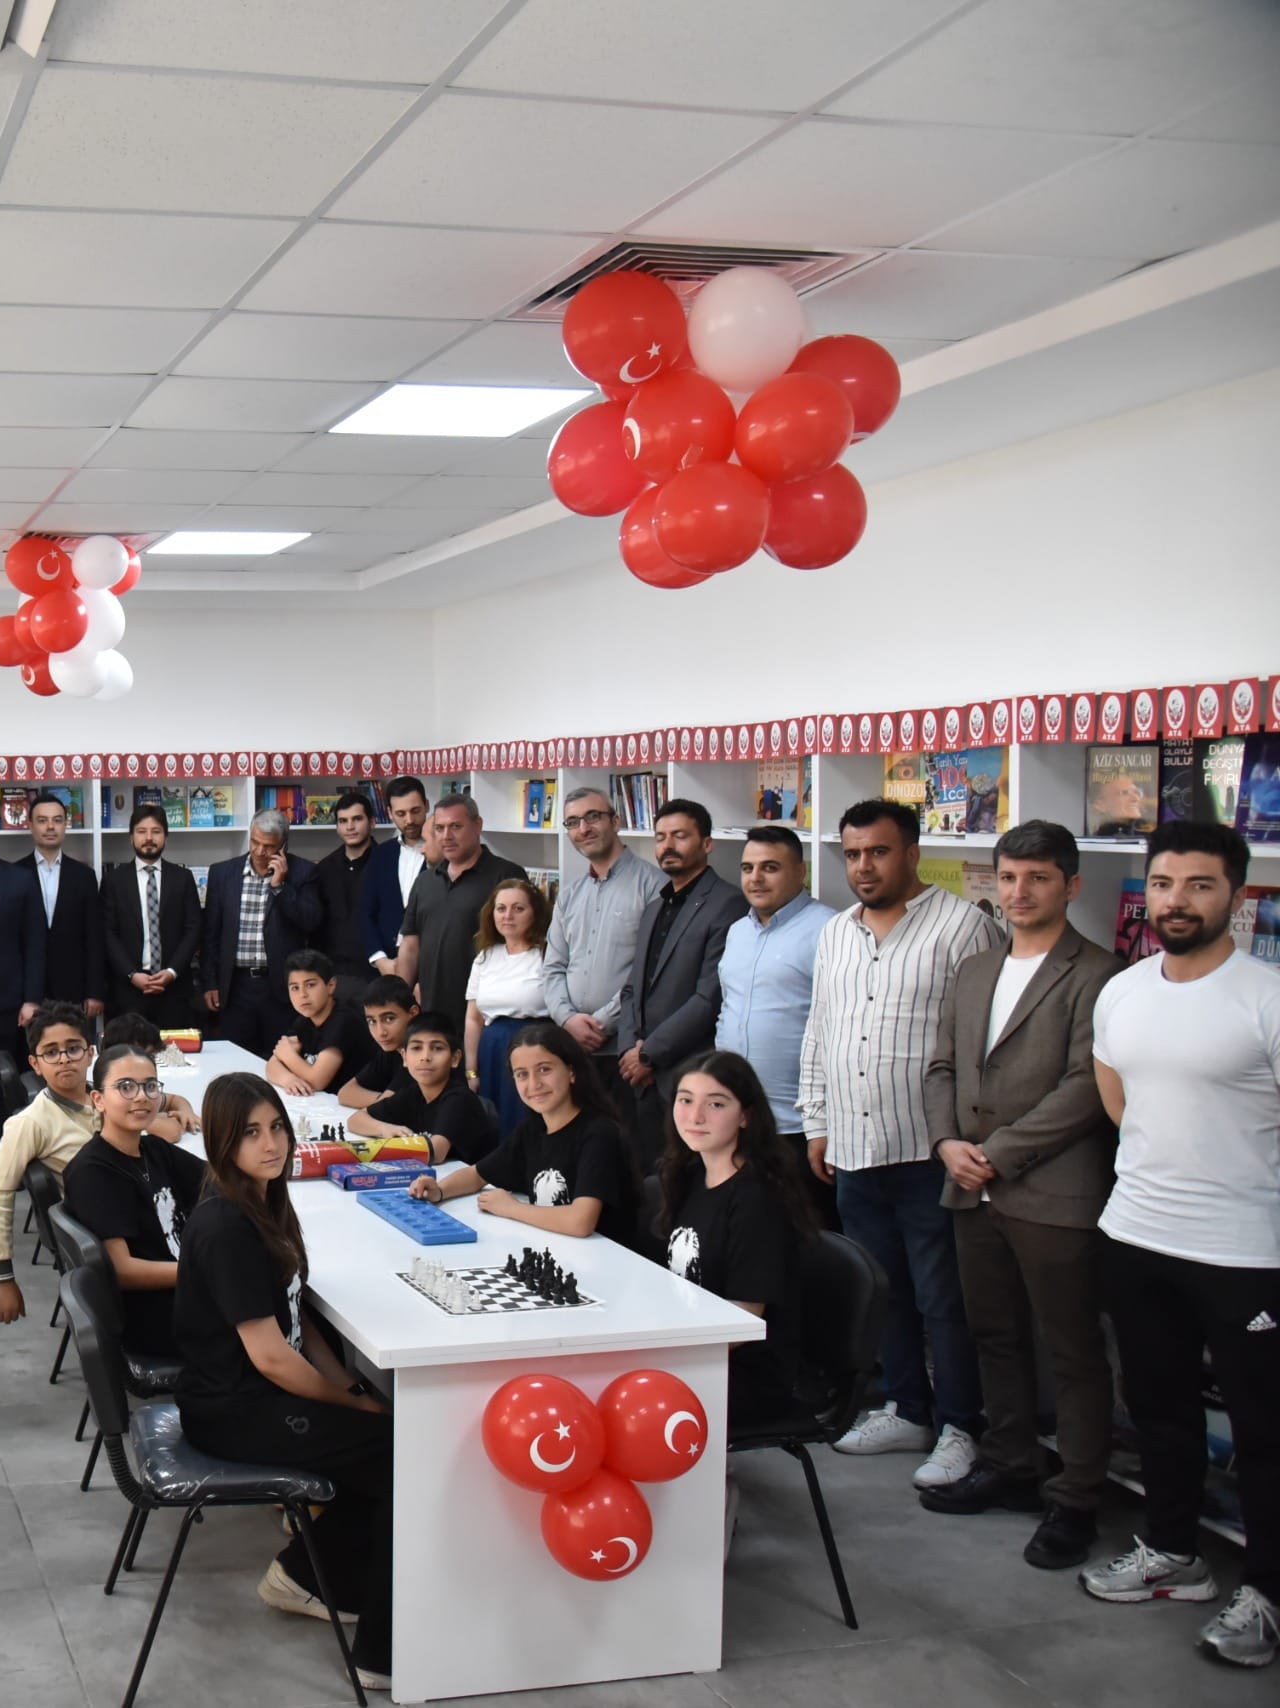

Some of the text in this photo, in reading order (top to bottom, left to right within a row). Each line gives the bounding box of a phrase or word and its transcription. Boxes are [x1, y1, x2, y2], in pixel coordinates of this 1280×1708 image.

[1233, 724, 1251, 732] ATA
[1102, 733, 1116, 741] ATA
[1114, 753, 1152, 768] SANCAR
[886, 783, 926, 798] DİNOZO
